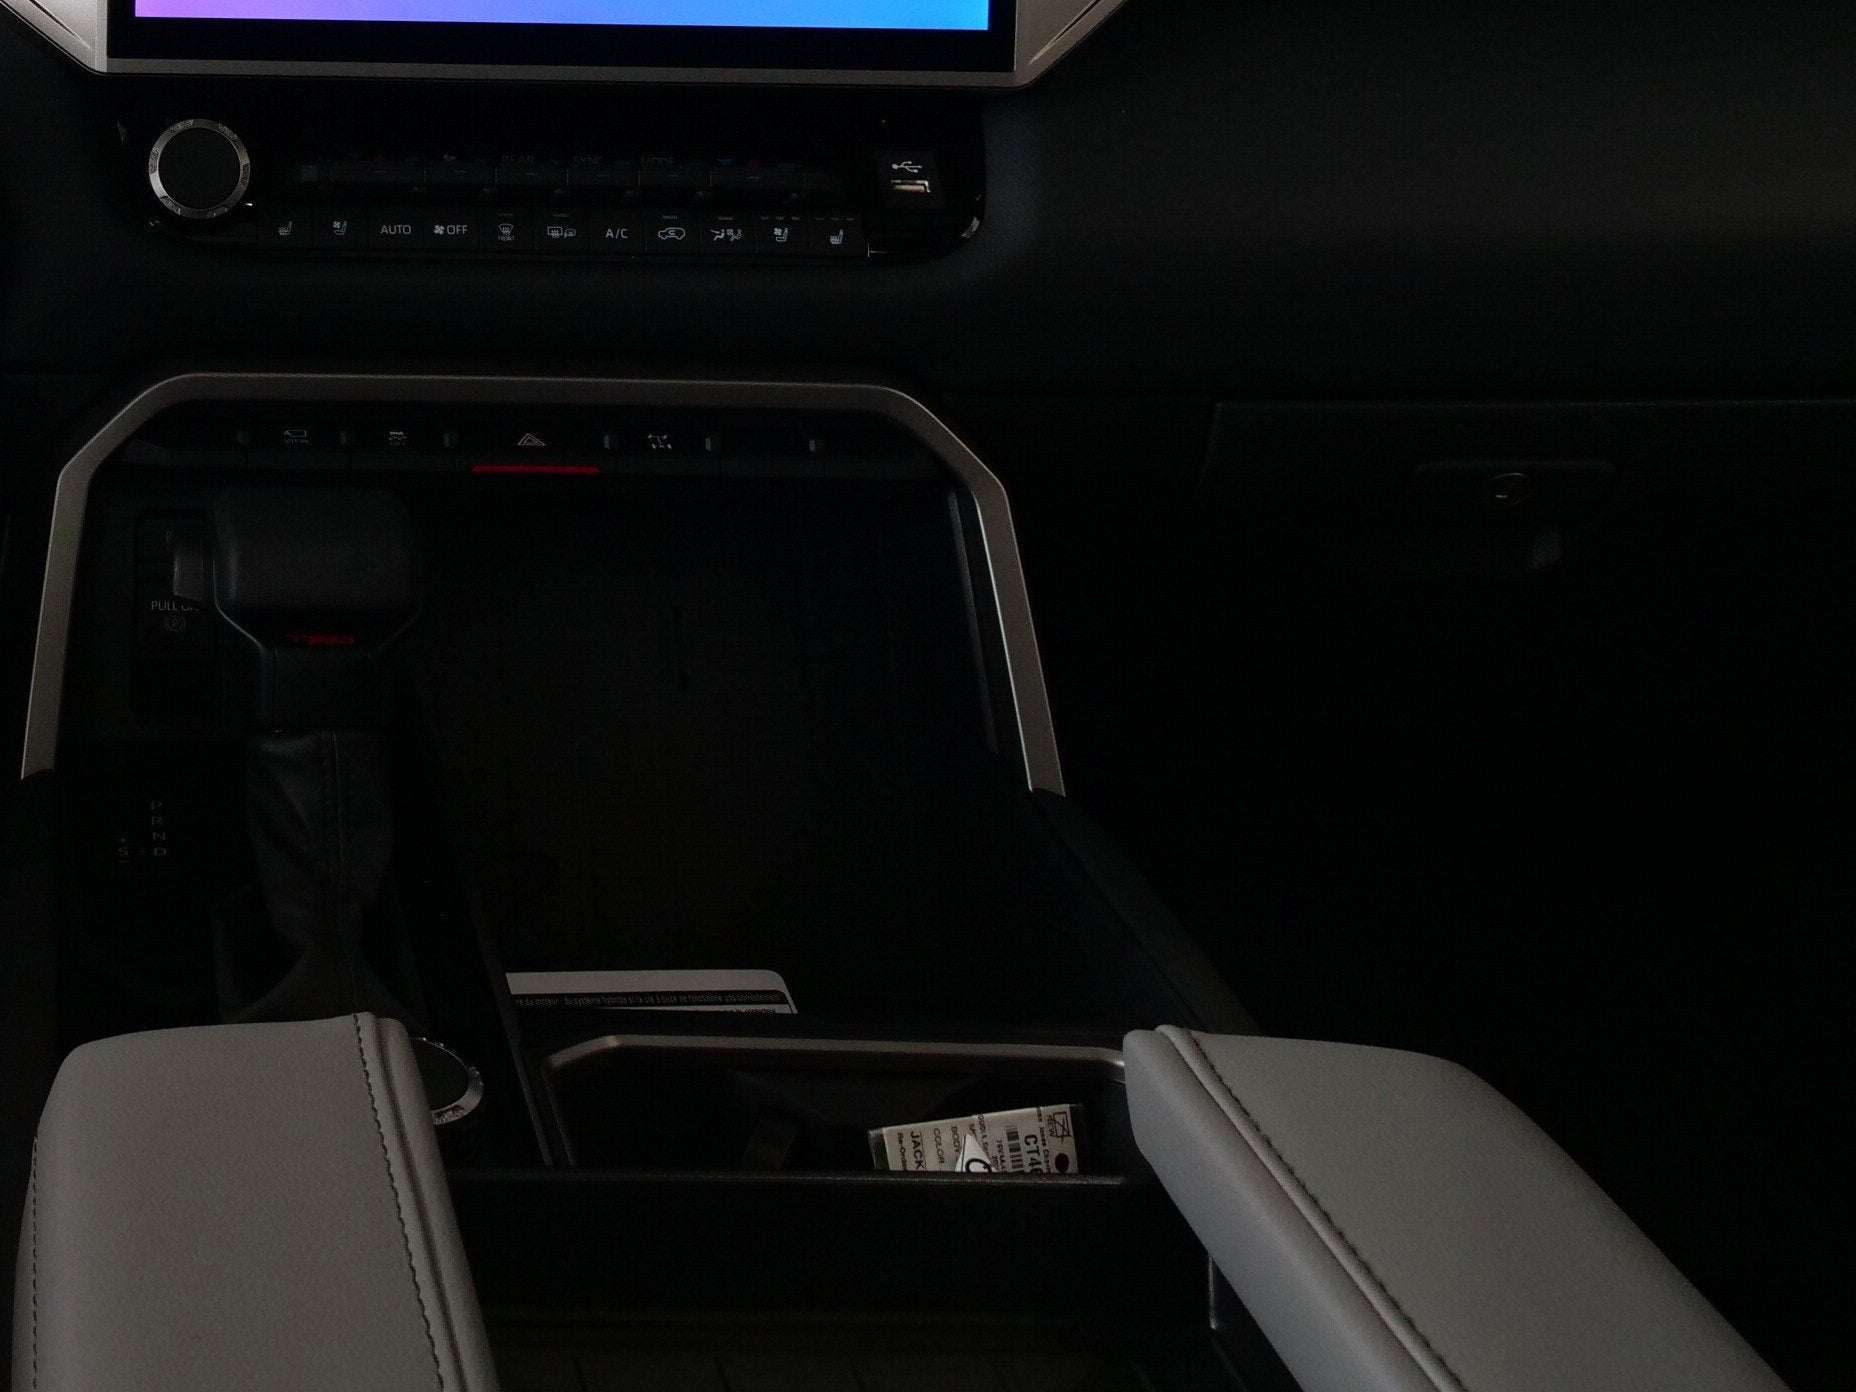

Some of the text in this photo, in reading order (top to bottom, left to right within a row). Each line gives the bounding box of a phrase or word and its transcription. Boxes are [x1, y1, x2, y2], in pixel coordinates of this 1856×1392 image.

[380, 224, 412, 235] AUTO
[446, 224, 469, 235] OFF
[605, 228, 628, 239] A/C
[150, 600, 177, 611] PULL
[910, 1131, 925, 1170] JACK
[933, 1128, 945, 1164] COLOR
